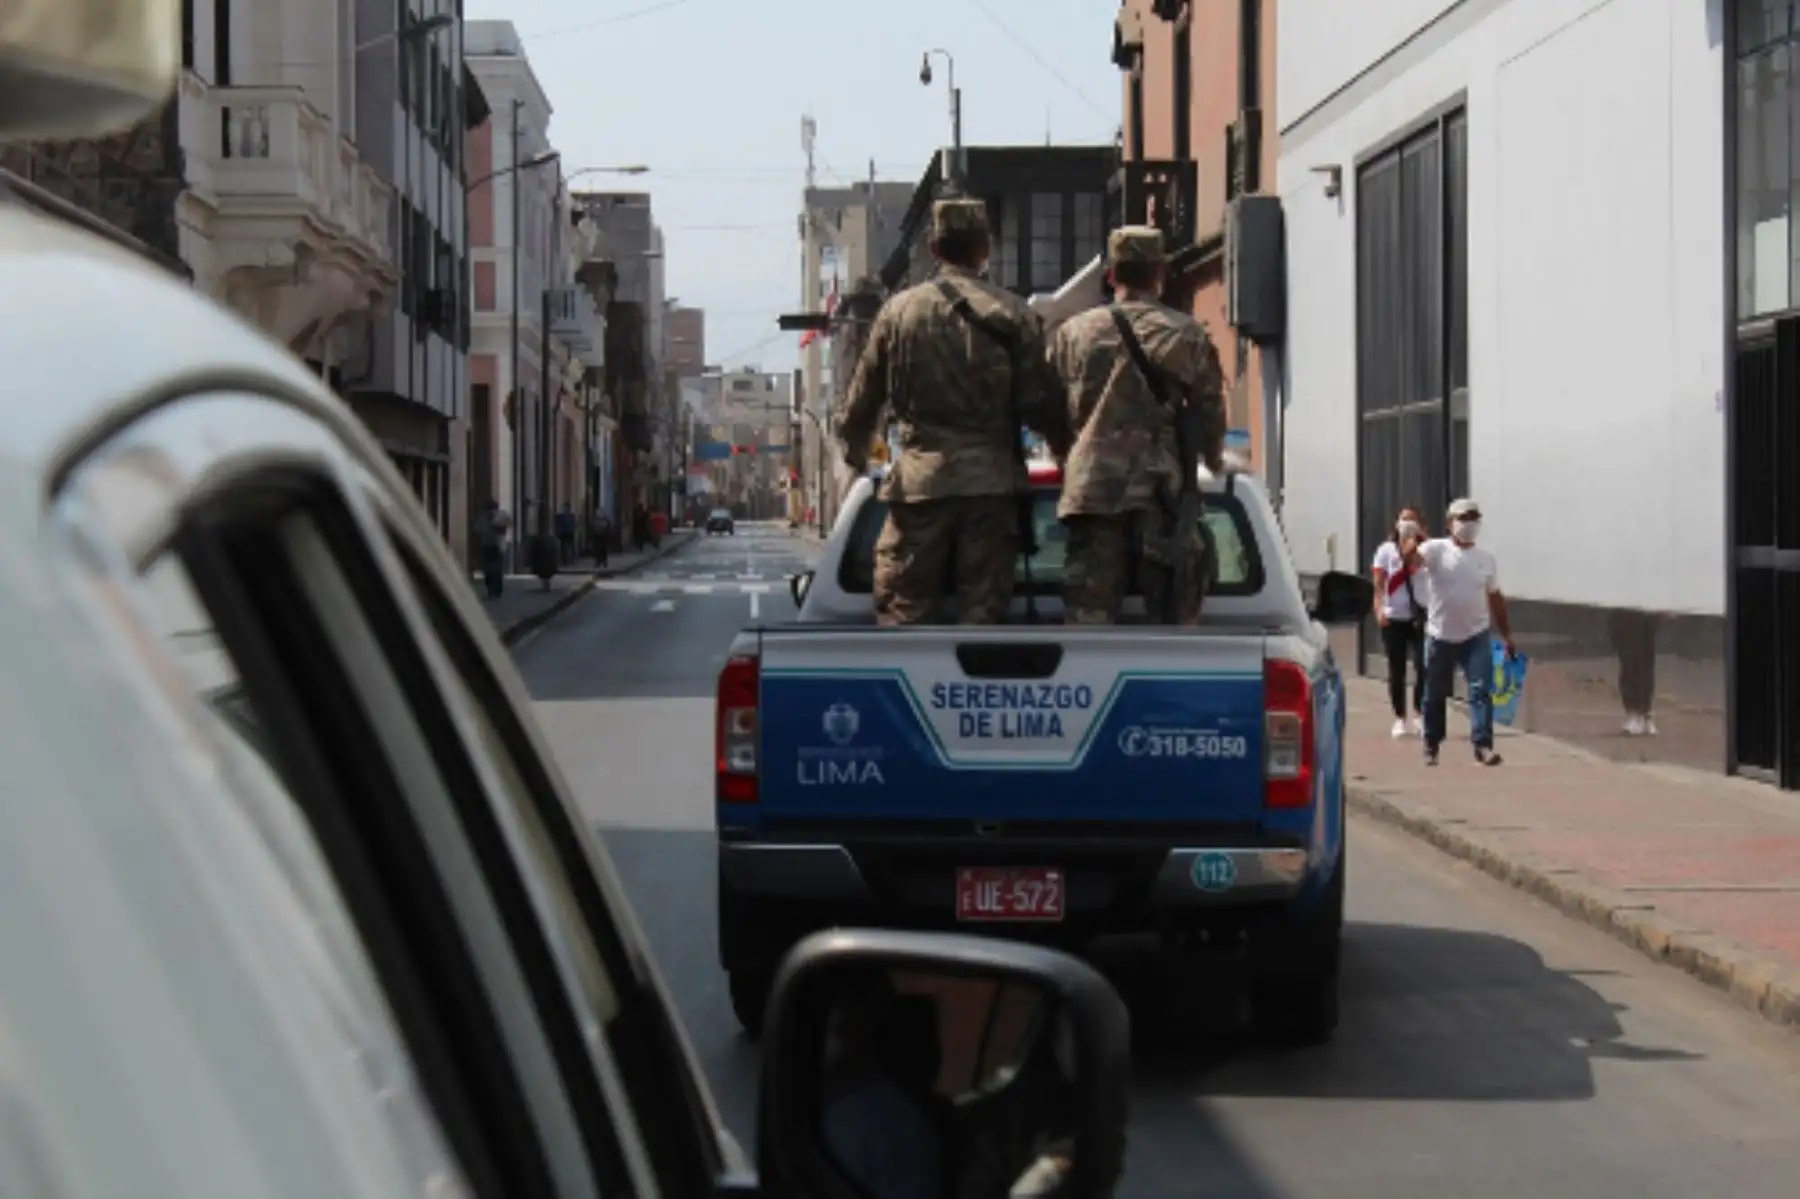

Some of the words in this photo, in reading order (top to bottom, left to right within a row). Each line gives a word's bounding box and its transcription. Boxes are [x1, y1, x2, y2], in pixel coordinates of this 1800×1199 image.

[931, 682, 1093, 709] SERENAZGO
[959, 711, 993, 738] DE
[1001, 711, 1064, 738] LIMA
[1149, 735, 1247, 758] 318-5050
[797, 759, 885, 785] LIMA
[1201, 862, 1228, 881] 112
